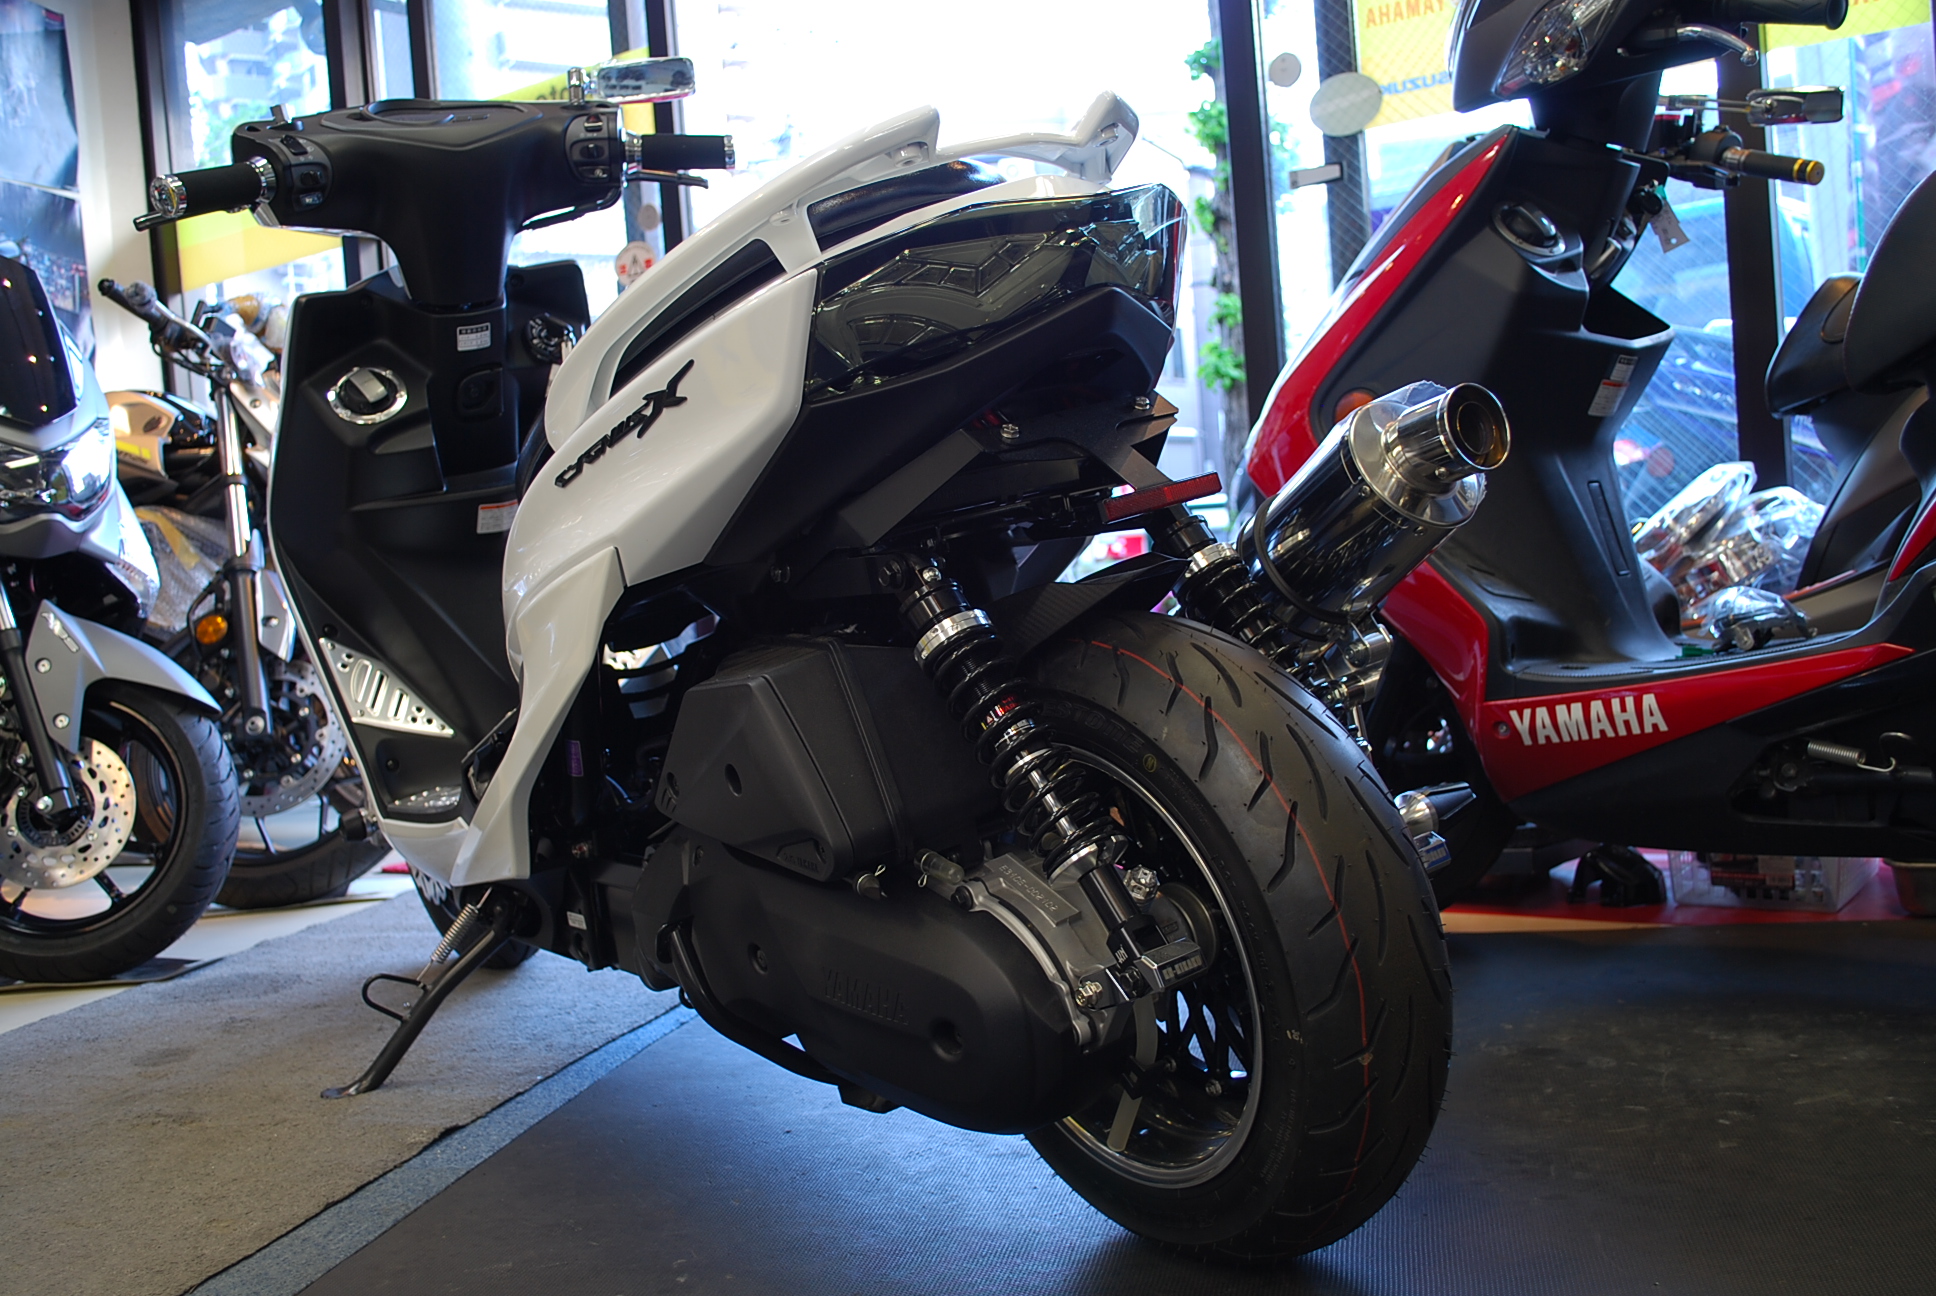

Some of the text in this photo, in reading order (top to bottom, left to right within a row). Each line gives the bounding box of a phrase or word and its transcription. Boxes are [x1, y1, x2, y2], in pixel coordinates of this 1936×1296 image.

[1041, 699, 1145, 753] ESTONE
[1509, 693, 1669, 746] YAMAHA
[822, 966, 909, 1026] YAMAHA
